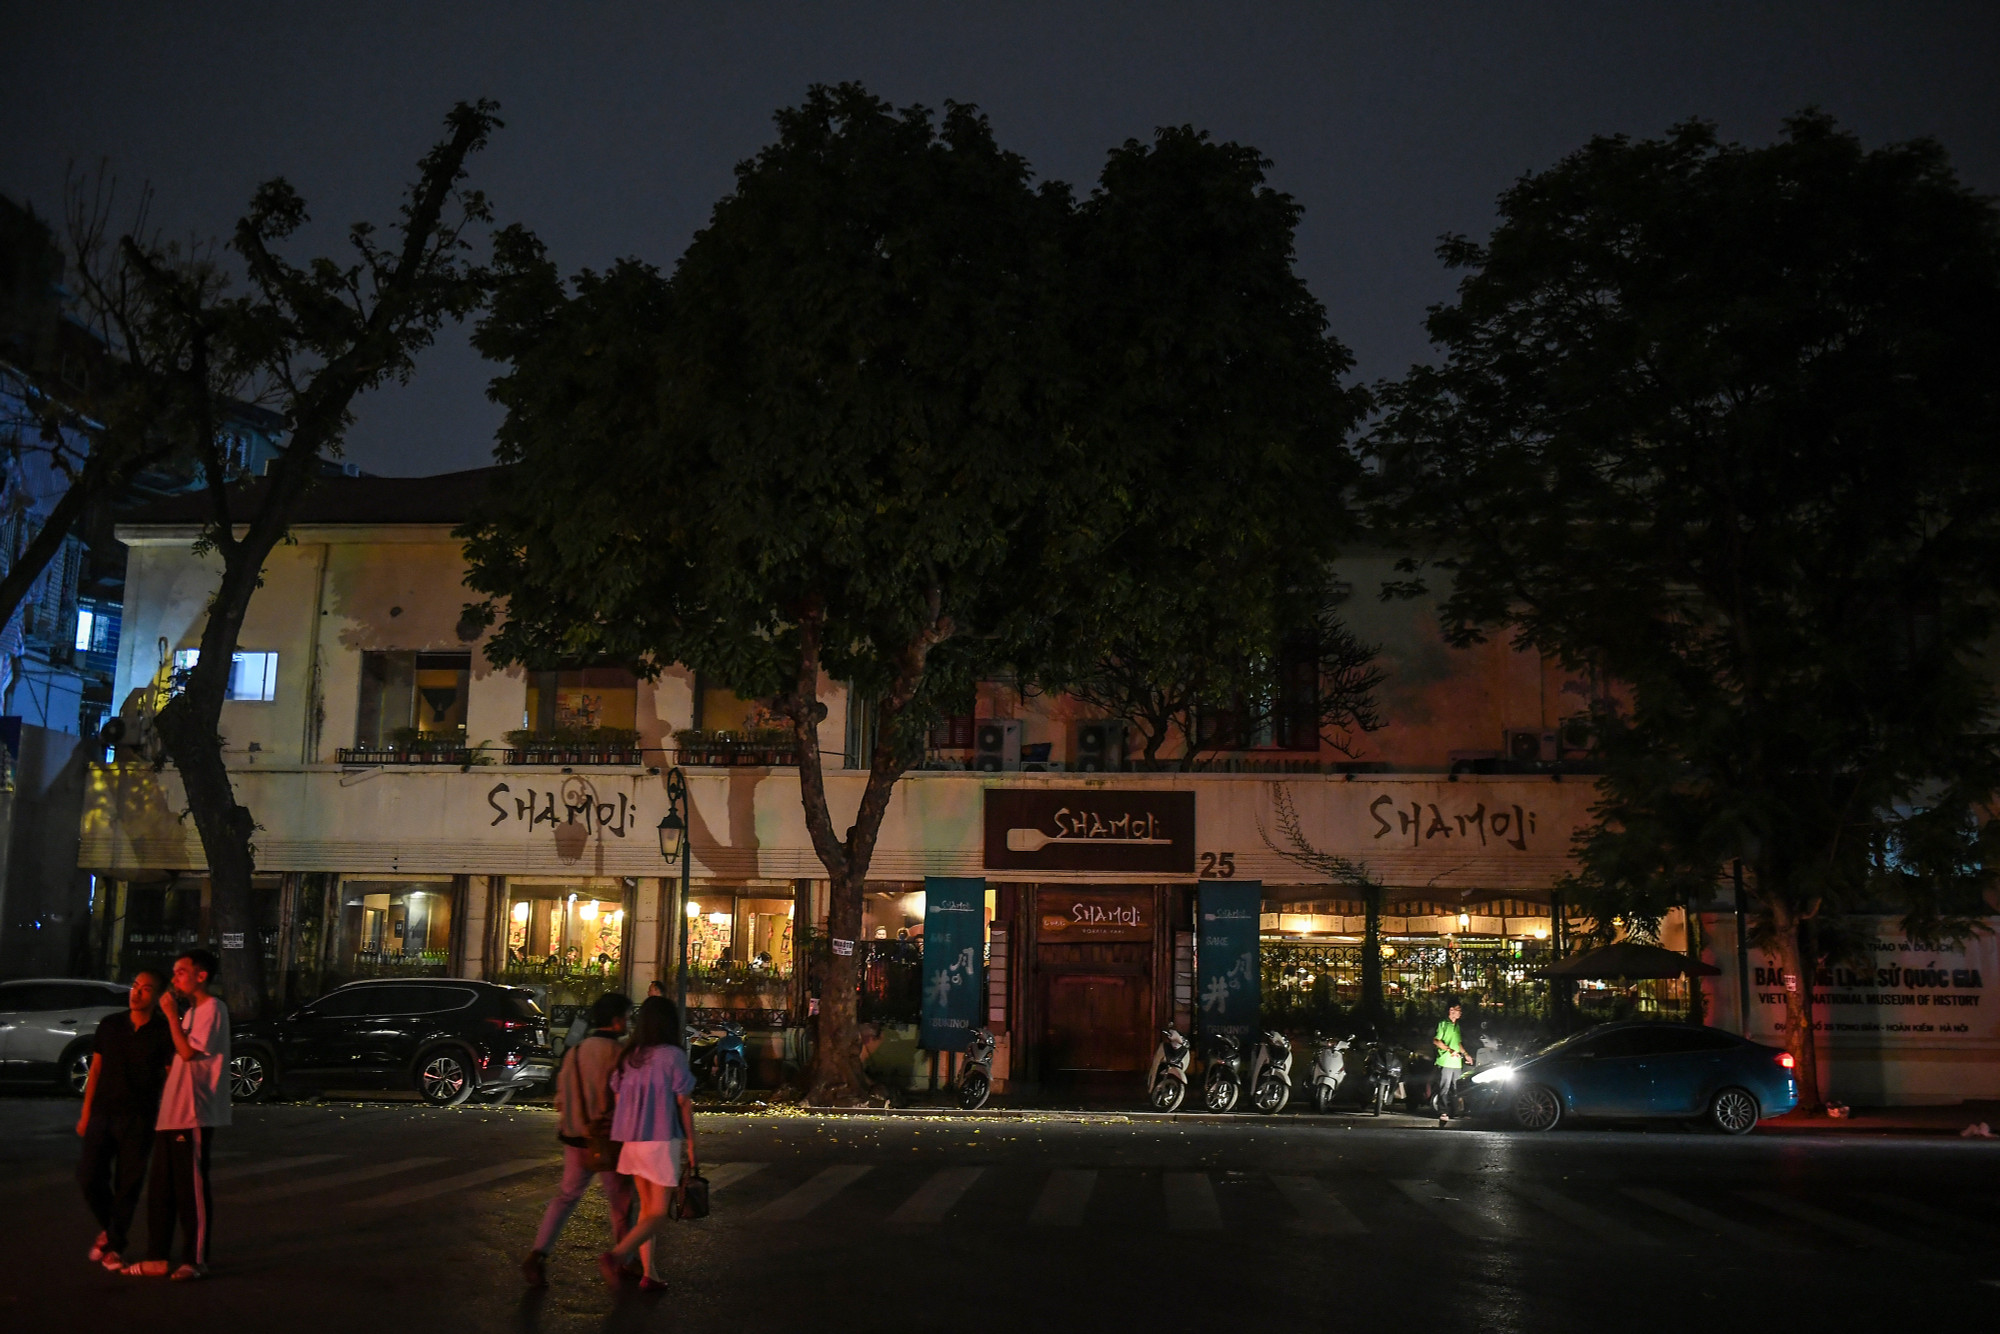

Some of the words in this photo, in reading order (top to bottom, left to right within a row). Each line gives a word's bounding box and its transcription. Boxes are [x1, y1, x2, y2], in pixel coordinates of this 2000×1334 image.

[1200, 852, 1235, 878] 25
[1878, 962, 1902, 988] SỬ
[1904, 961, 1949, 989] QUỐC
[1952, 969, 1983, 988] GIA
[1811, 994, 1864, 1005] NATIONAL
[1866, 994, 1915, 1006] MUSEUM
[1917, 995, 1931, 1006] OF
[1933, 995, 1980, 1006] HISTORY
